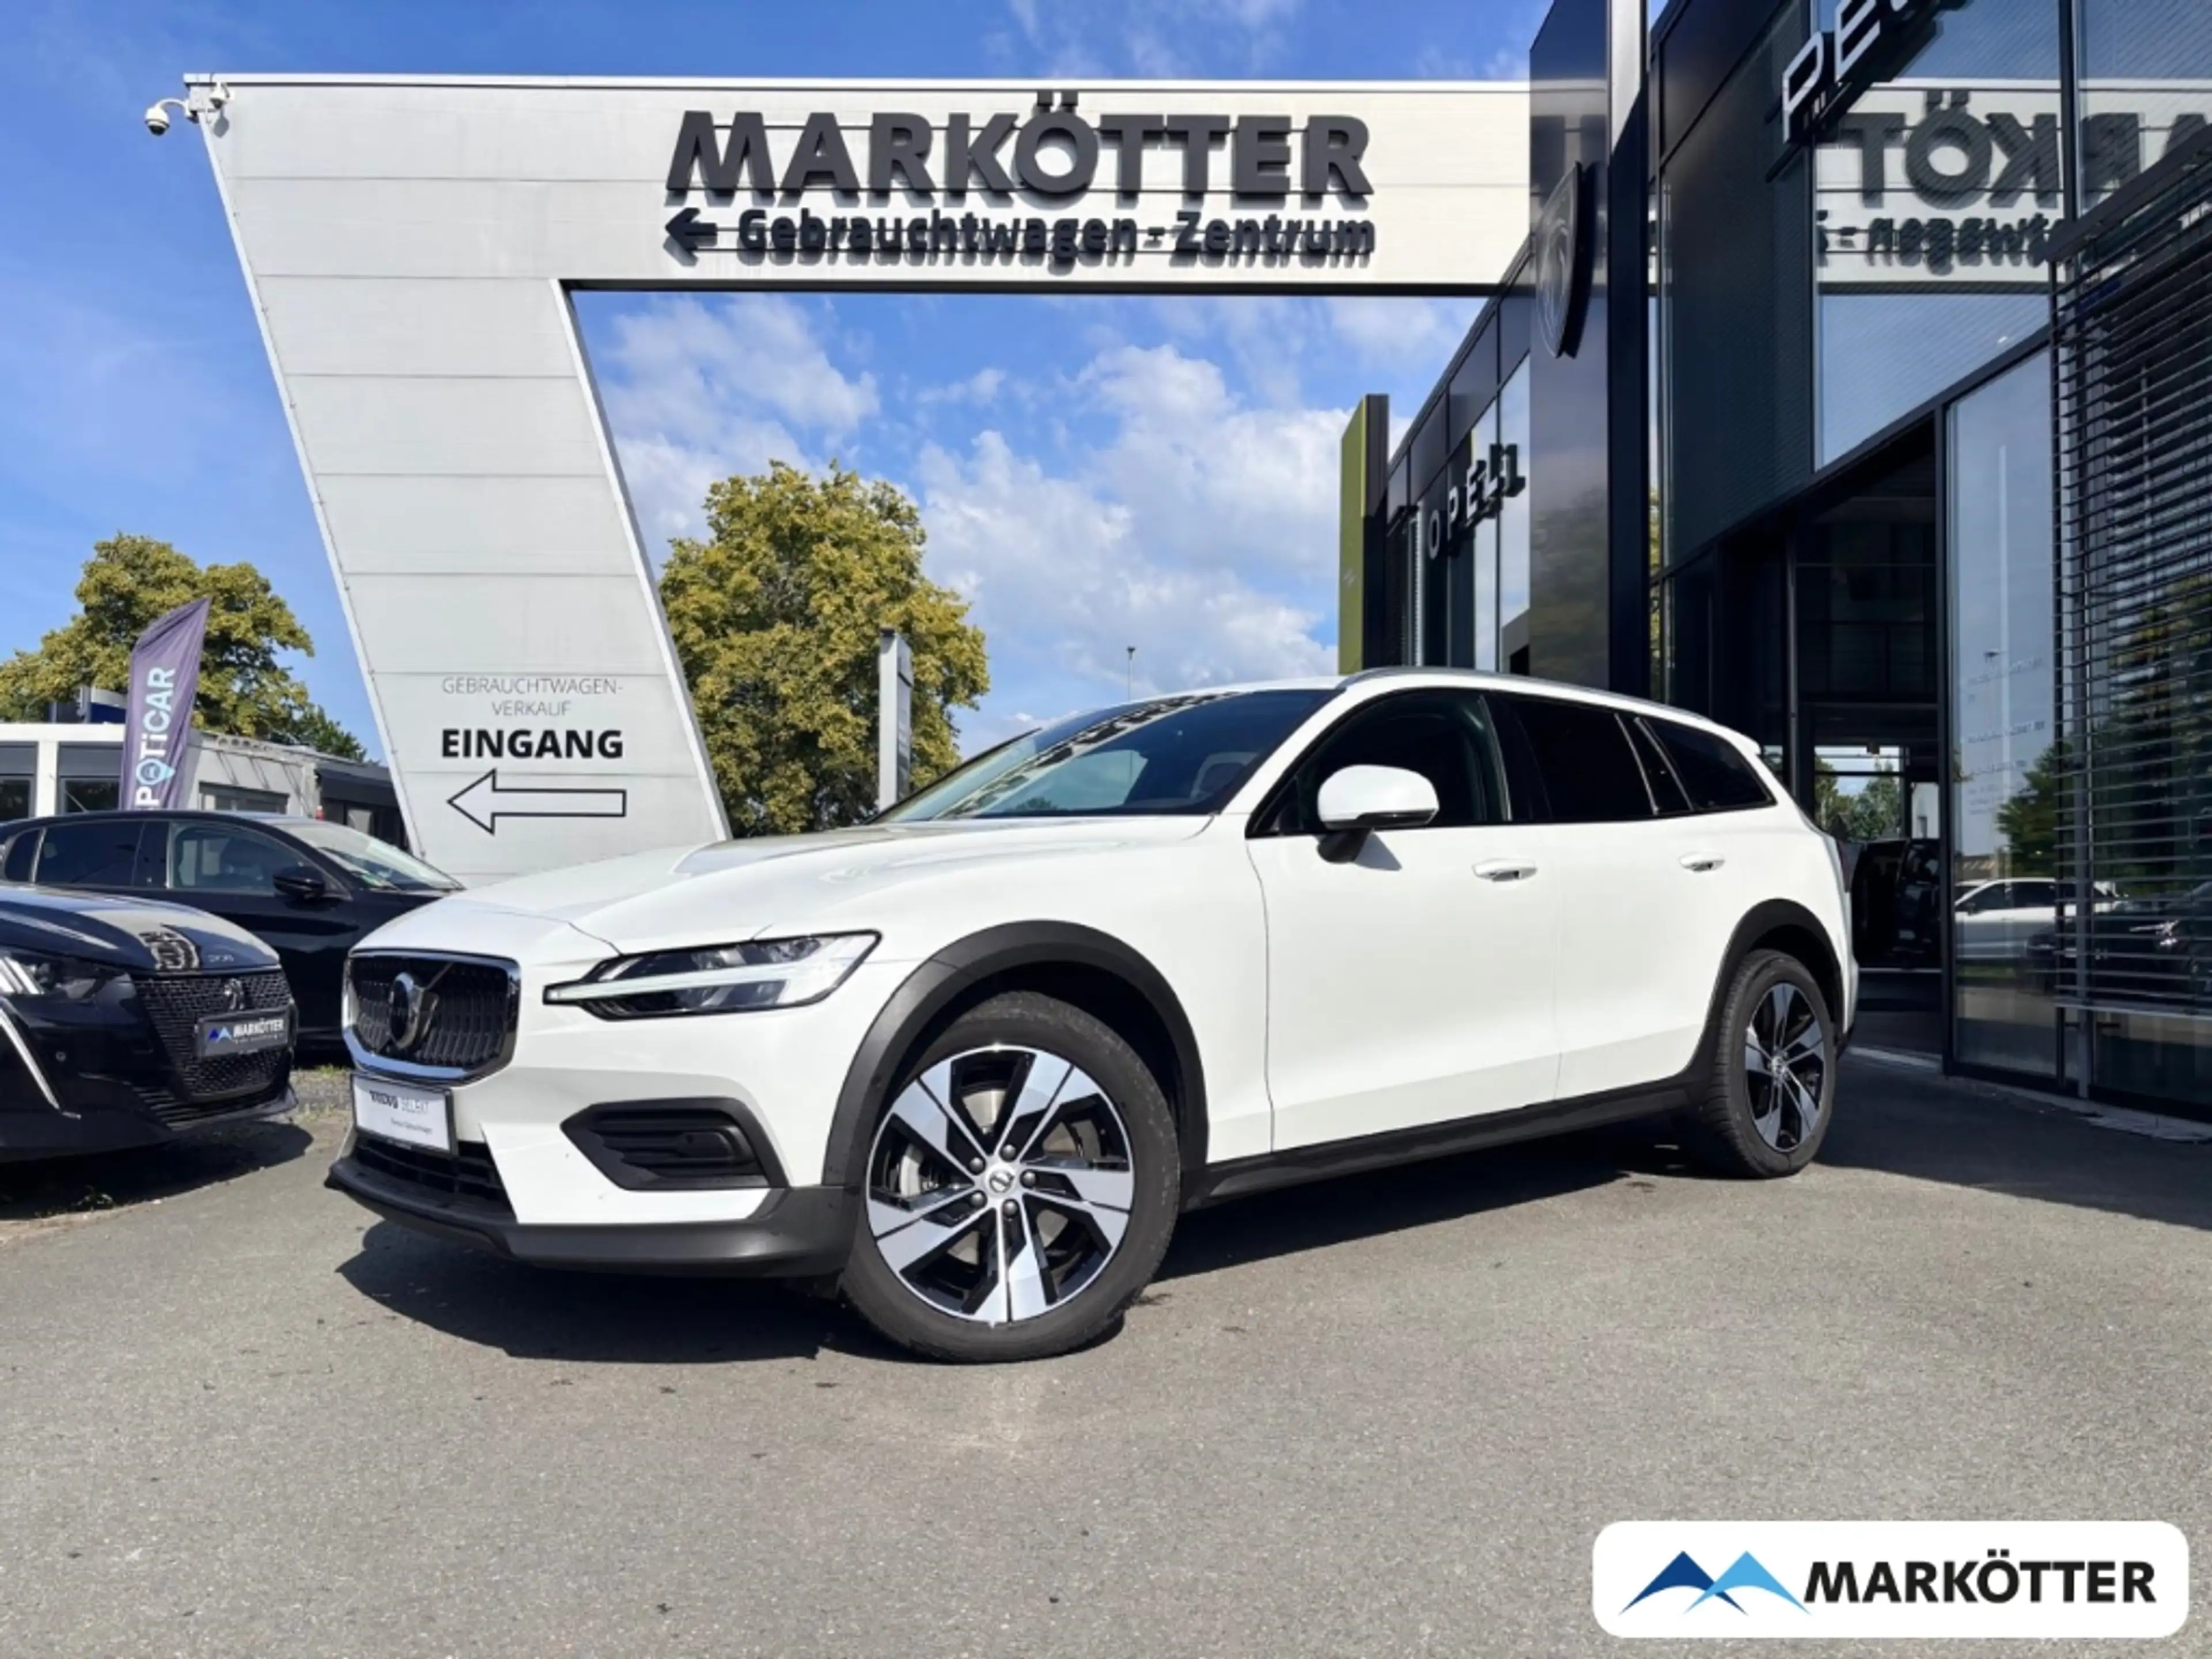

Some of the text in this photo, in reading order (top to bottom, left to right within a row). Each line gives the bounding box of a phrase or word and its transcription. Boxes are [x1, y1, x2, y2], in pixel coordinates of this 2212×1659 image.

[1782, 0, 1908, 144] PE
[666, 90, 1374, 198] MARKÖTTER
[1428, 443, 1525, 560] OPEL
[441, 677, 623, 695] GEBRAUCHTWAGEN-
[491, 700, 572, 717] VERKAUF
[442, 728, 624, 759] EINGANG
